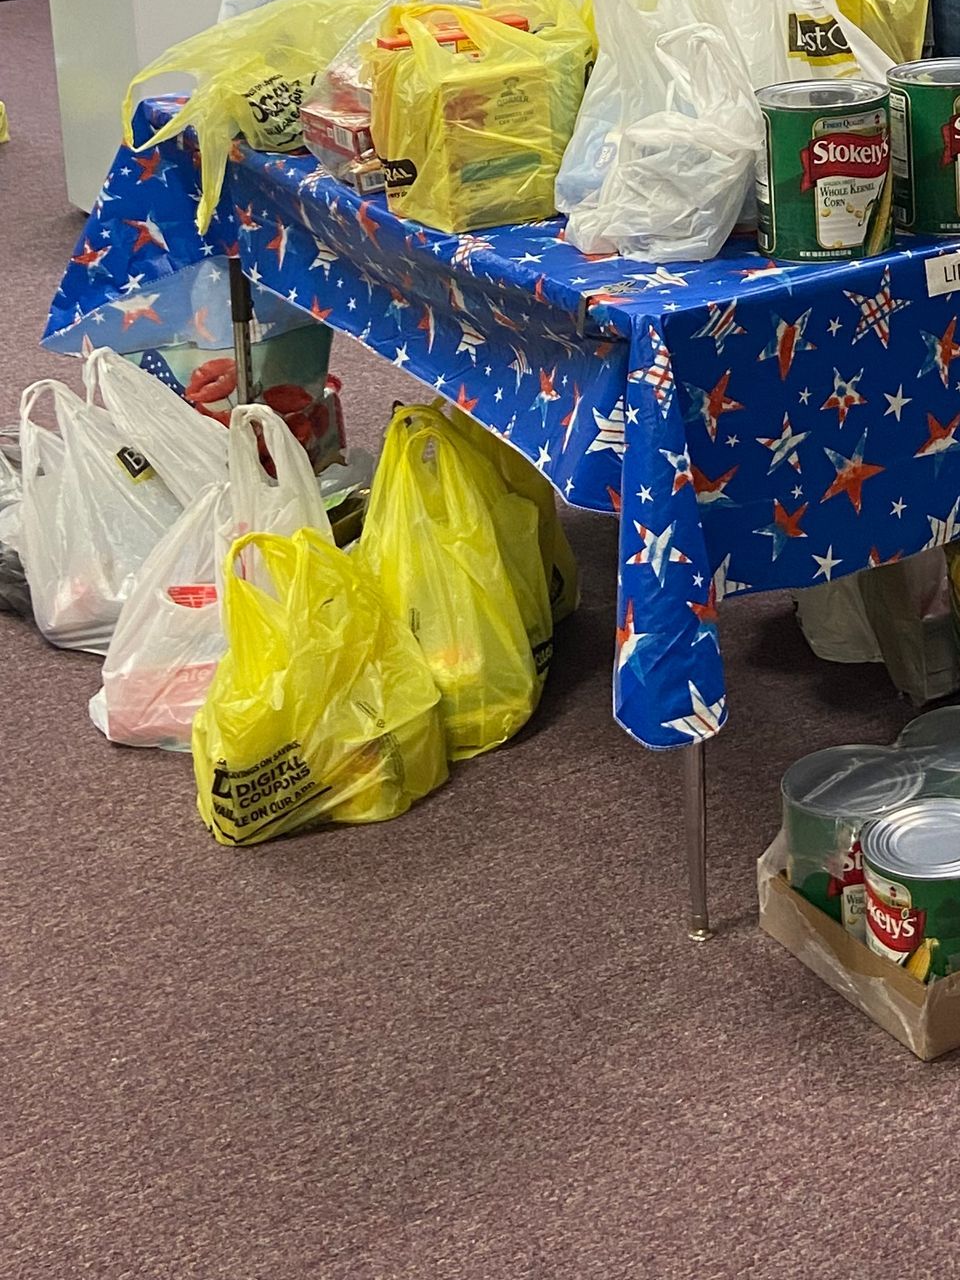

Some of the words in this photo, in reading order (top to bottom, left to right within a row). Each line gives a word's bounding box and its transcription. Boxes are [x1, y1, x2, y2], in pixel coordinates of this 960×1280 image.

[813, 135, 889, 166] Stokely's
[820, 185, 849, 197] WHOLE
[850, 182, 876, 195] KERNEL
[823, 196, 846, 208] CORN
[236, 755, 307, 797] DIGITAL
[239, 765, 311, 809] COUPONS
[250, 807, 269, 822] ON
[269, 795, 294, 814] OUR
